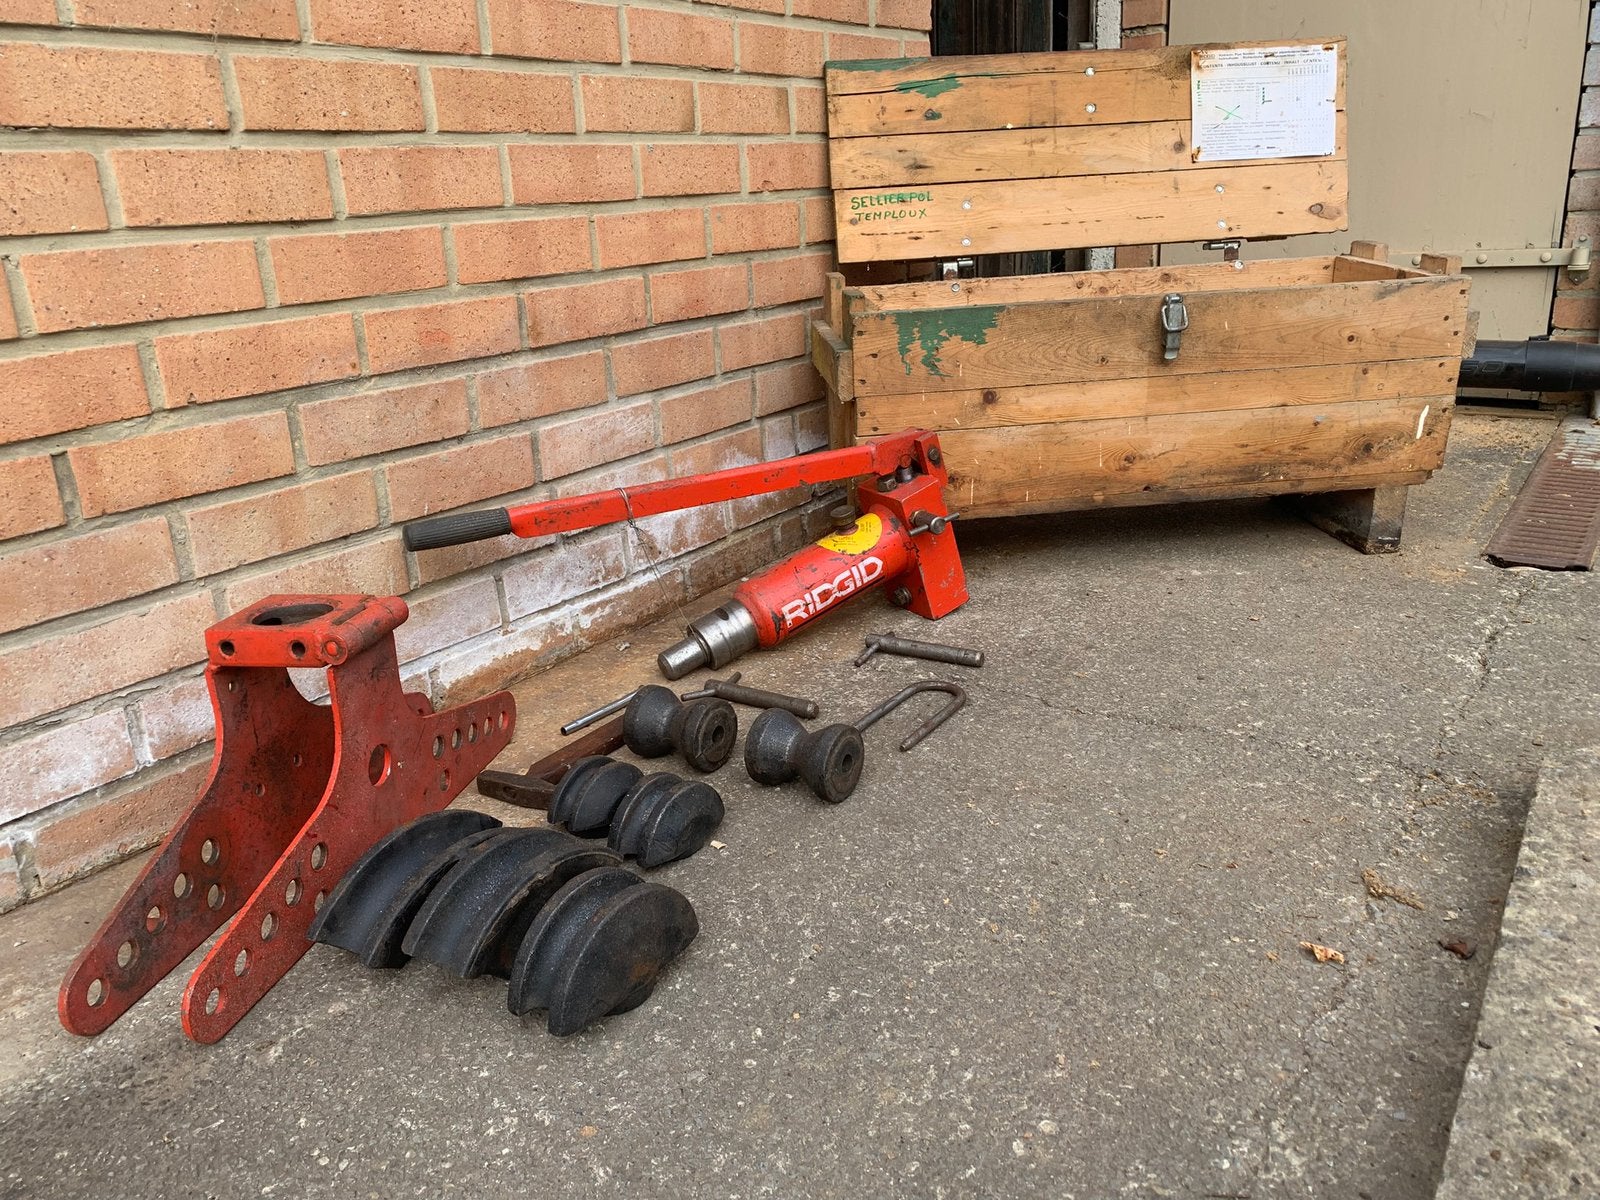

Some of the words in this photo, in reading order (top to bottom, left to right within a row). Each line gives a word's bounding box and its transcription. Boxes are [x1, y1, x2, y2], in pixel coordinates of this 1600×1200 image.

[850, 193, 906, 211] SELLIER
[854, 208, 928, 222] TEMPLOUX
[781, 556, 884, 629] RIDGID
